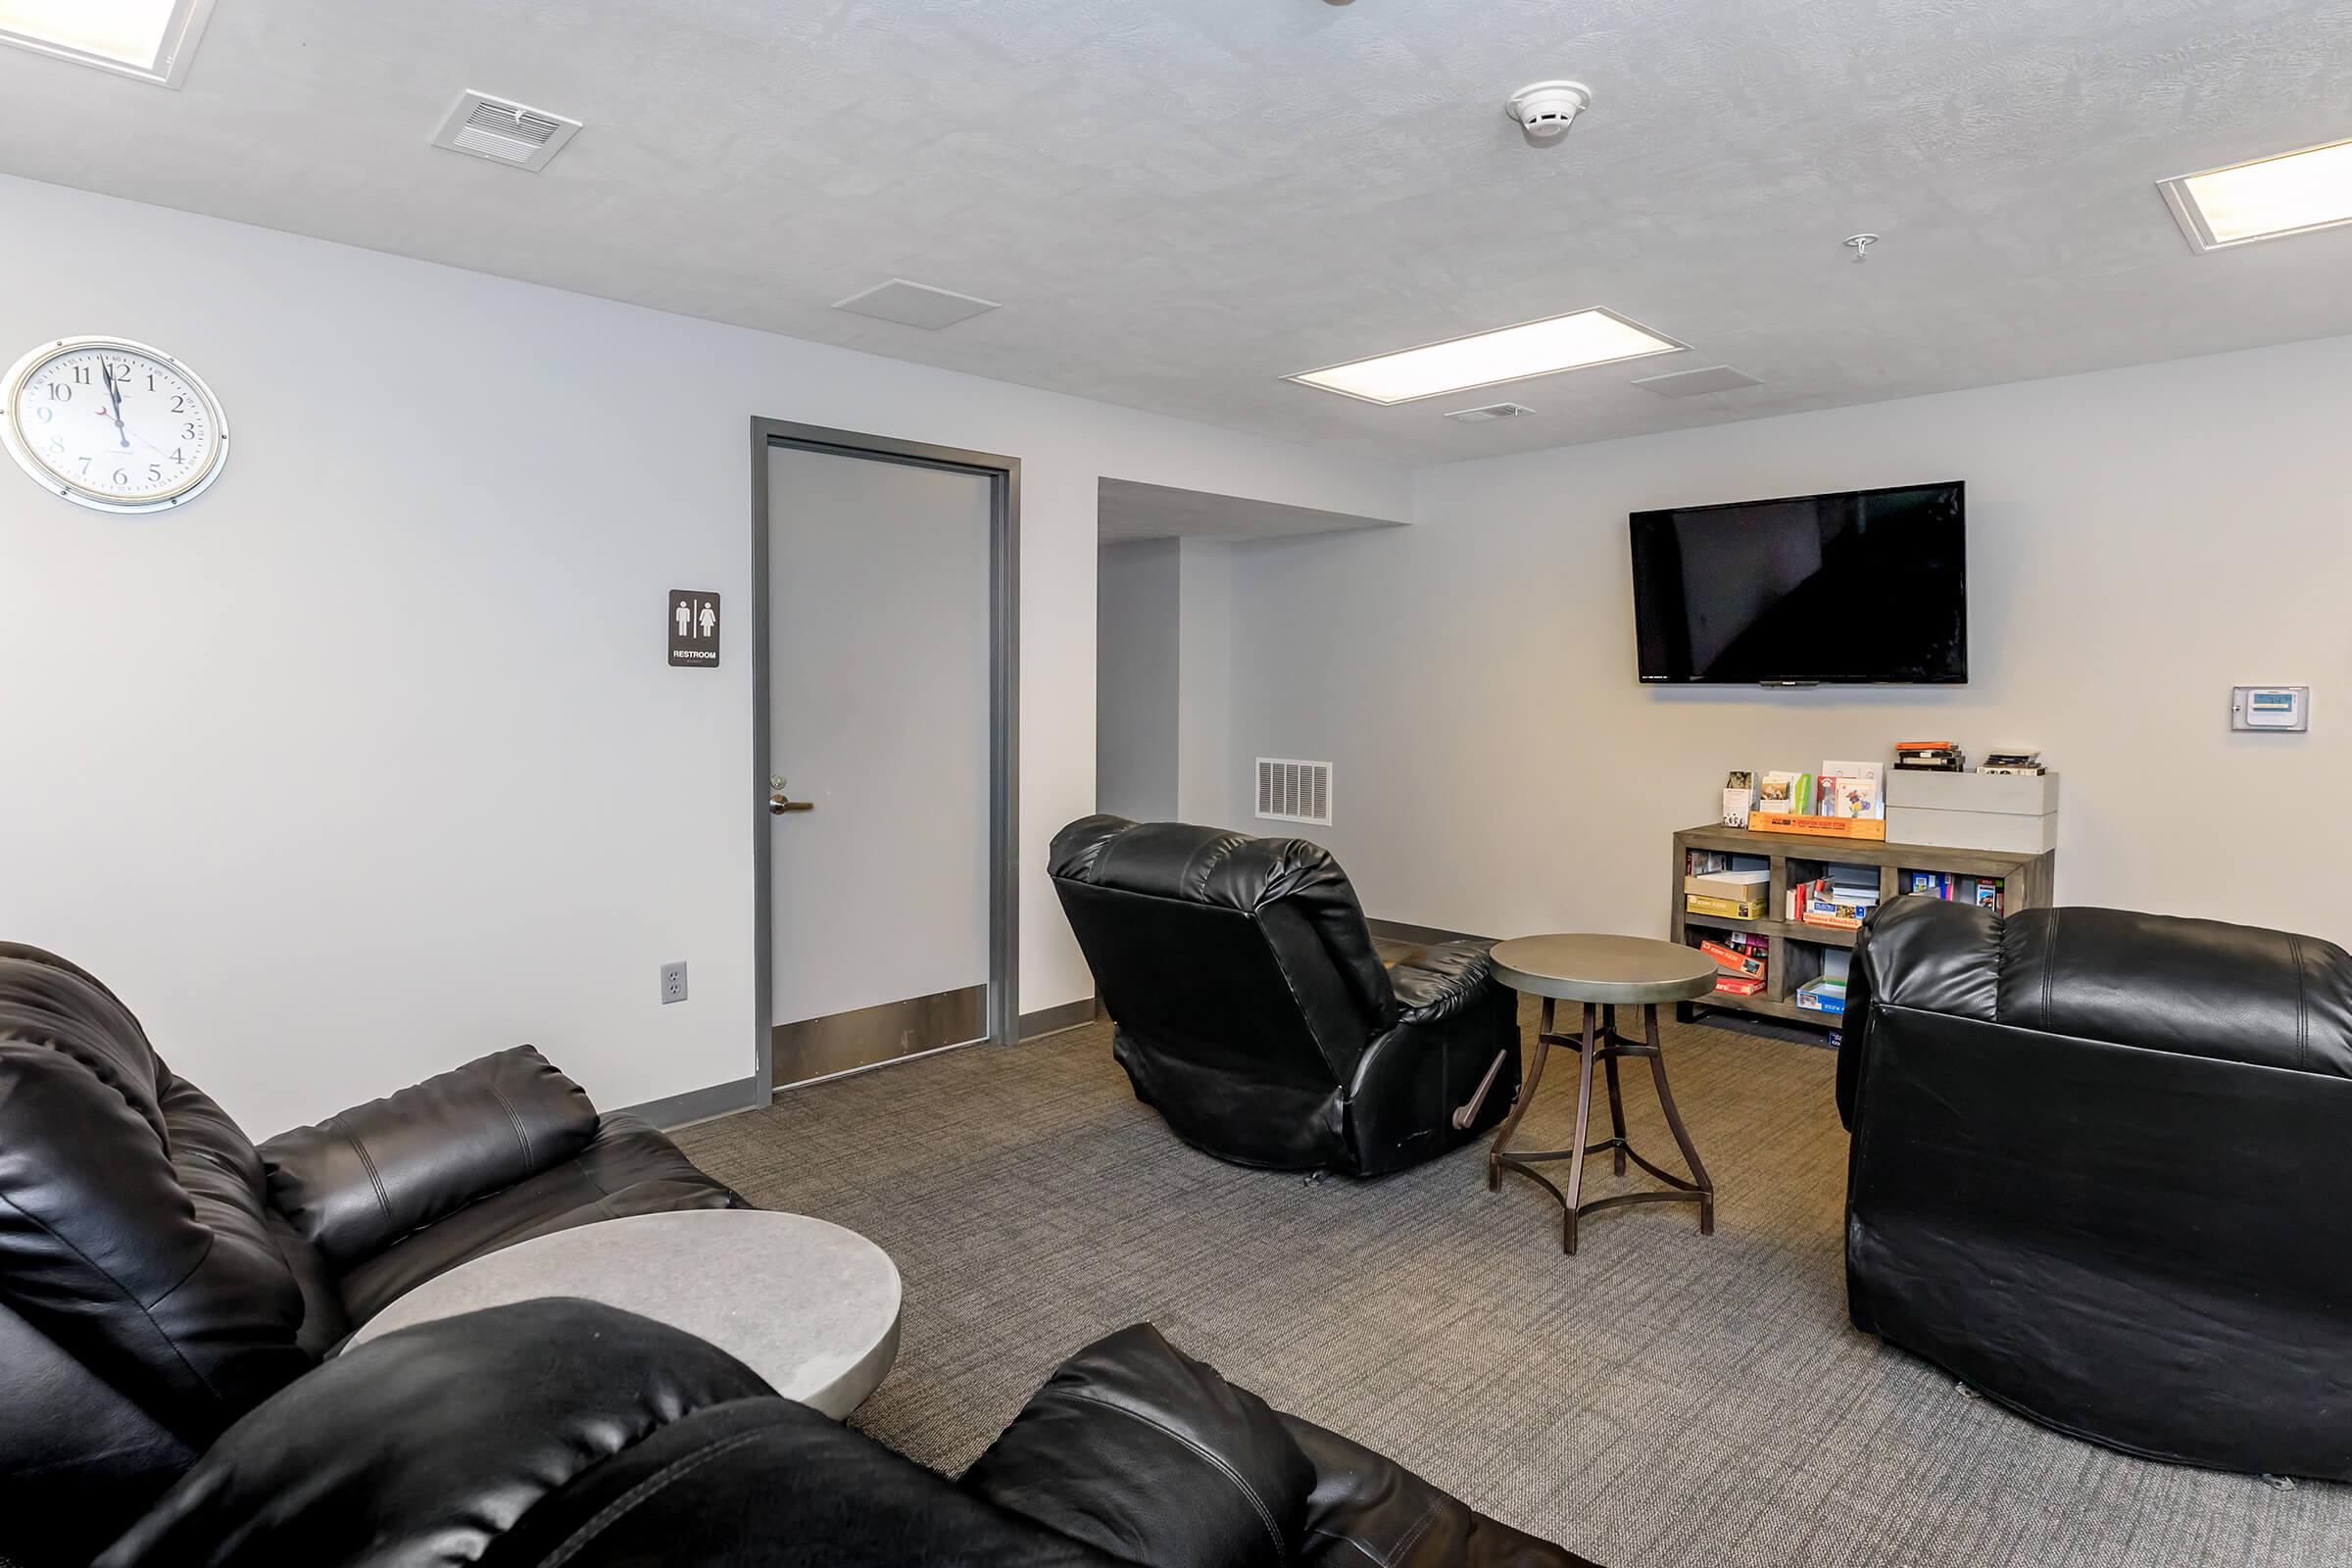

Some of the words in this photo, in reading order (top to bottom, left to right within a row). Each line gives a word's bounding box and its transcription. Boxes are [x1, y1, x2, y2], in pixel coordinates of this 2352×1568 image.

[73, 366, 92, 385] 11
[106, 363, 131, 383] 12
[146, 373, 156, 392] 1
[47, 382, 72, 402] 10
[171, 395, 184, 414] 2
[36, 406, 53, 423] 9
[180, 422, 195, 440] 3
[49, 434, 65, 454] 8
[169, 447, 186, 465] 4
[78, 457, 93, 475] 7
[147, 464, 161, 482] 5
[113, 467, 127, 485] 6
[673, 650, 716, 659] RESTROOM
